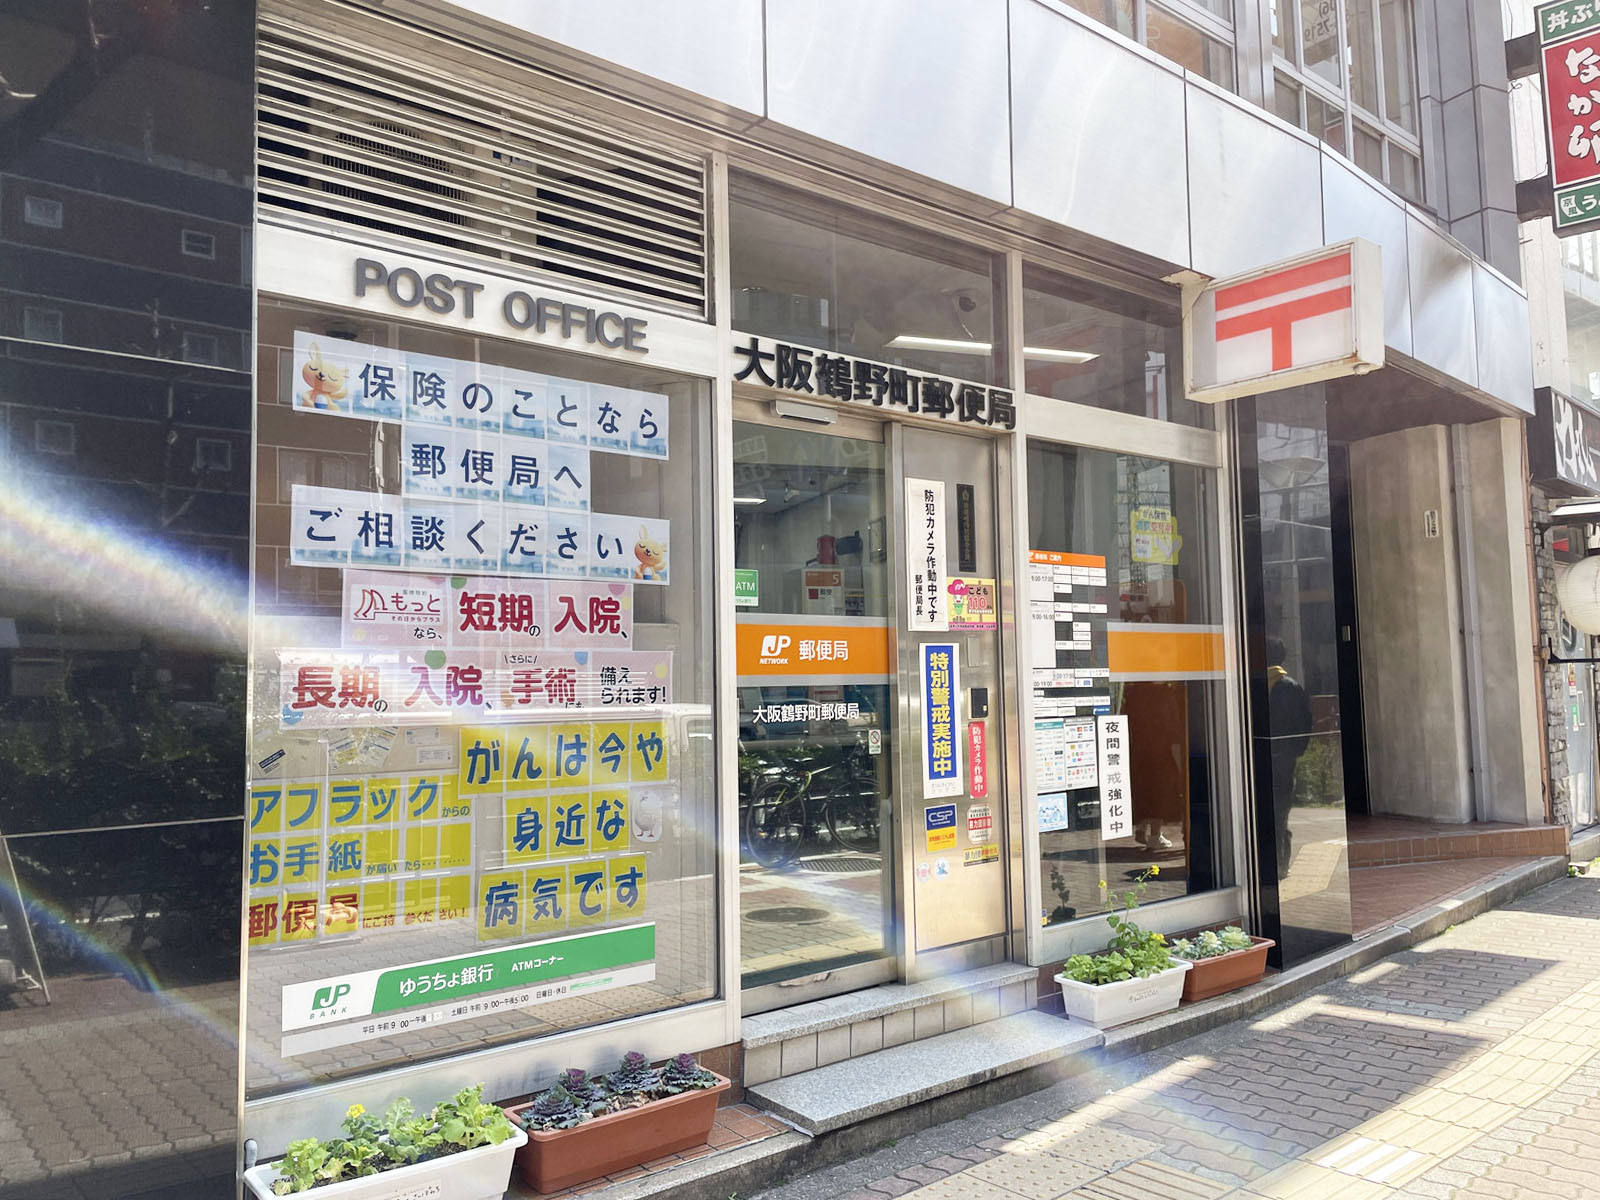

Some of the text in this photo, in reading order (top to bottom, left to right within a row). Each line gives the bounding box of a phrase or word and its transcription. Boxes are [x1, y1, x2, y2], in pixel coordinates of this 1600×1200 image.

[1547, 0, 1600, 33] 丼ぶ
[1582, 195, 1600, 212] う
[354, 257, 649, 354] POST OFFICE
[358, 362, 659, 440] 保険のことなら
[733, 337, 1017, 431] 大阪鶴野町郵便局
[411, 443, 583, 490] 郵便局へ
[306, 507, 624, 561] ご相談ください
[924, 489, 938, 623] 防犯カメラ作動中です
[736, 581, 756, 592] ATM
[832, 573, 840, 585] 5
[914, 574, 923, 616] 郵便局長
[968, 586, 989, 596] こども
[391, 592, 440, 613] もっと
[413, 627, 443, 640] なら、
[760, 635, 791, 657] JP
[799, 640, 849, 661] 郵便局
[600, 666, 633, 686] 備え
[752, 702, 860, 724] 大阪鶴野町郵便局
[929, 651, 953, 777] 特別警戒実施中
[466, 731, 664, 785] がんは今や
[972, 726, 984, 793] 防犯カメラ作動中
[1105, 721, 1124, 834] 夜間警戒強化中
[512, 798, 625, 853] 身近な
[928, 810, 953, 823] CSP
[484, 866, 644, 928] 病気です
[399, 954, 566, 998] ゆうちょ銀行 ATMコーナー
[309, 1006, 348, 1020] BANK
[311, 983, 351, 1011] JP
